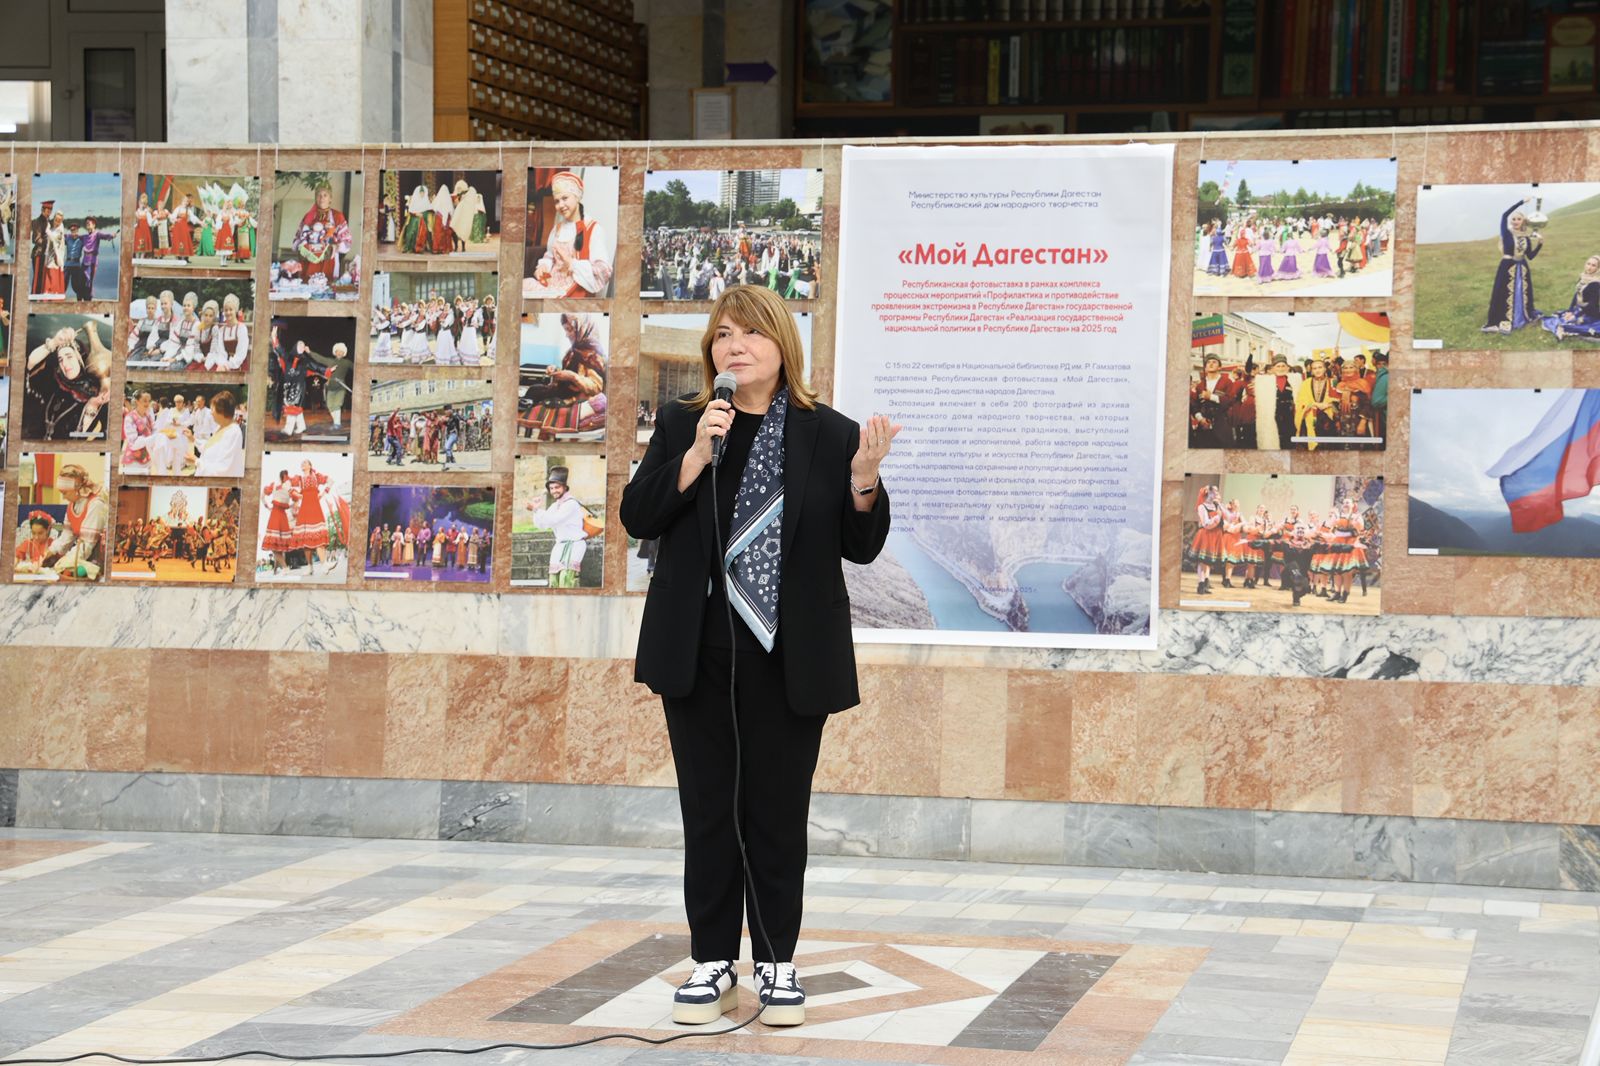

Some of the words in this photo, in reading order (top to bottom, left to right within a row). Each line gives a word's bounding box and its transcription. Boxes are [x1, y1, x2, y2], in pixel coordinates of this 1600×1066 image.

[909, 191, 968, 199] Министерство
[1010, 190, 1059, 199] Республики
[1061, 190, 1102, 198] Дагестан
[911, 201, 982, 209] Республиканский
[898, 242, 966, 265] «Мой
[972, 243, 1108, 267] Дагестан»
[902, 280, 968, 289] Республиканская
[970, 280, 1024, 288] фотовыставка
[930, 291, 982, 300] мероприятий
[983, 292, 1043, 300] «Профилактика
[1051, 292, 1118, 300] противодействие
[978, 302, 1024, 311] Республике
[1025, 302, 1064, 311] Дагестан»
[1066, 302, 1133, 311] государственной
[922, 314, 968, 322] Республики
[969, 314, 1004, 322] Дагестан
[1006, 314, 1056, 322] «Реализация
[1057, 314, 1124, 322] государственной
[884, 325, 939, 333] национальной
[983, 325, 1029, 333] Республике
[1030, 325, 1070, 333] Дагестан»
